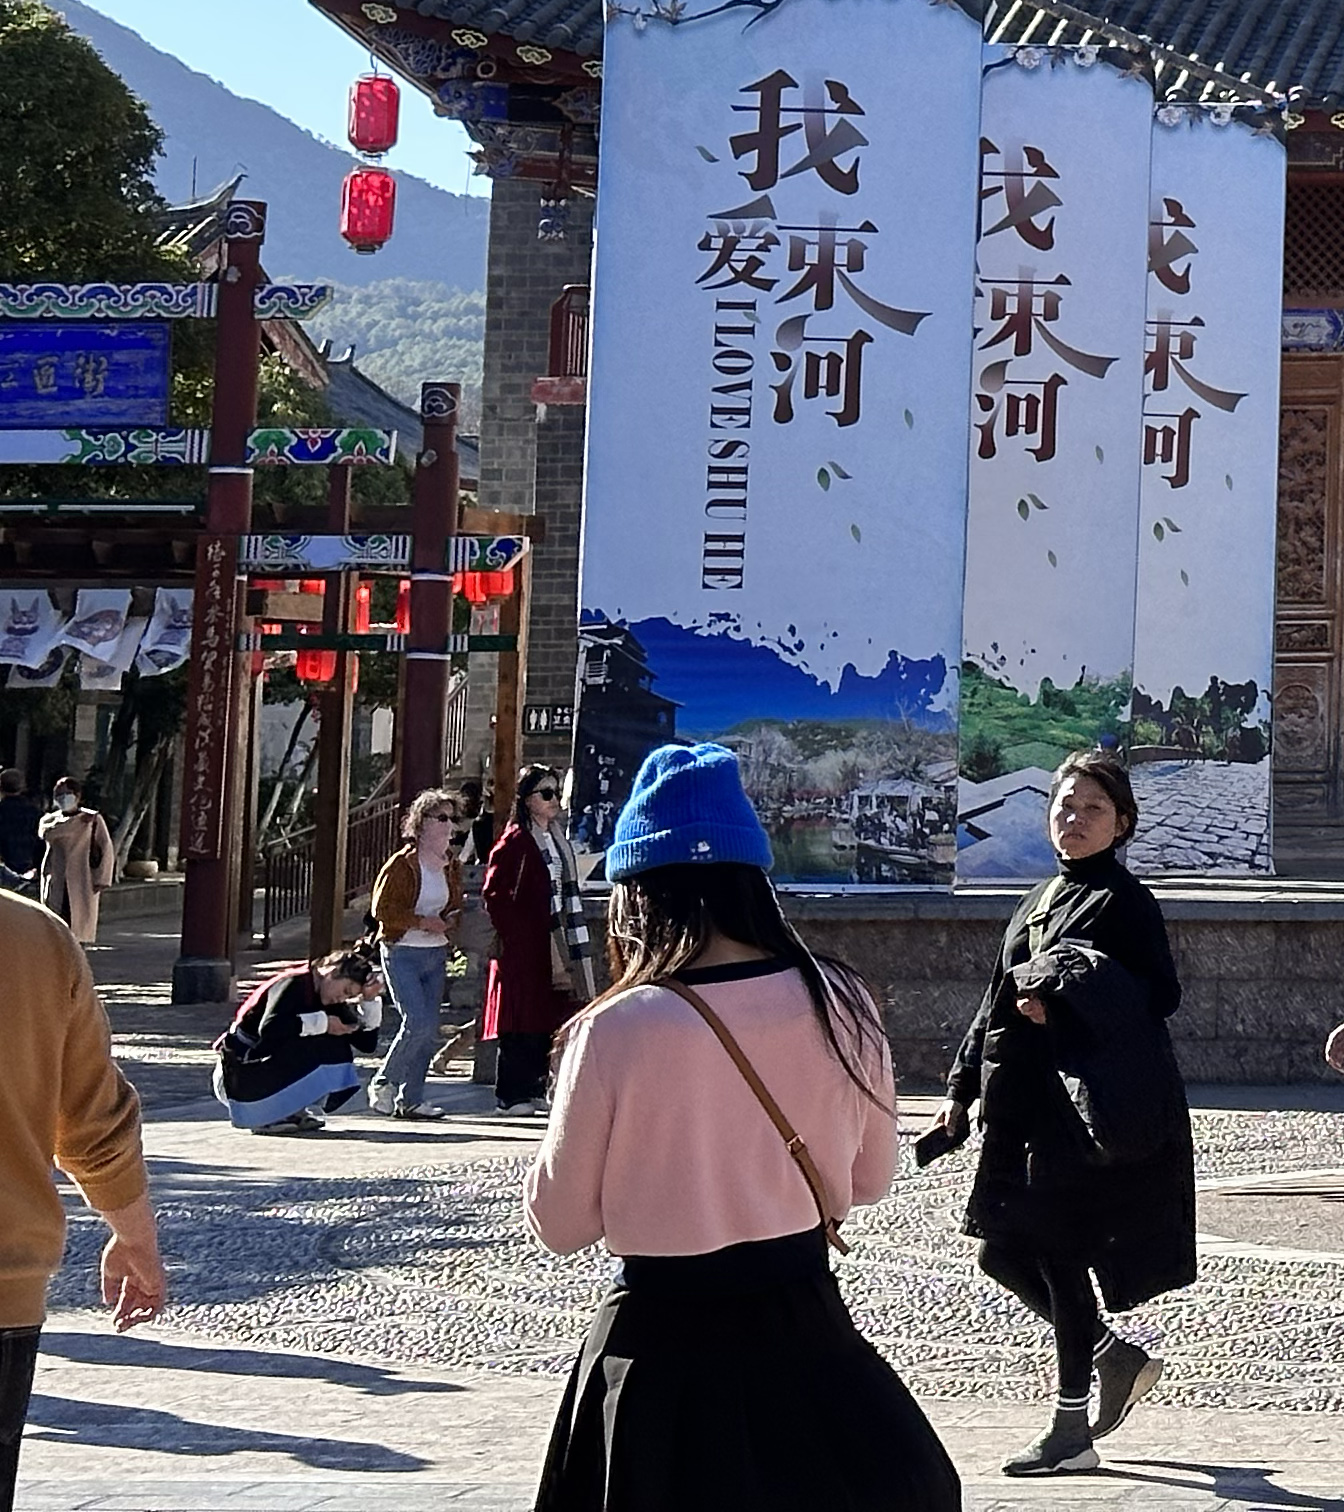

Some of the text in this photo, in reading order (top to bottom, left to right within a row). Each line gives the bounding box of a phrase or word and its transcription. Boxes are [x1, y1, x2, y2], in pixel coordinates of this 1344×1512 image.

[709, 320, 756, 430] LOVE
[704, 438, 751, 524] SHU
[701, 530, 746, 590] HE
